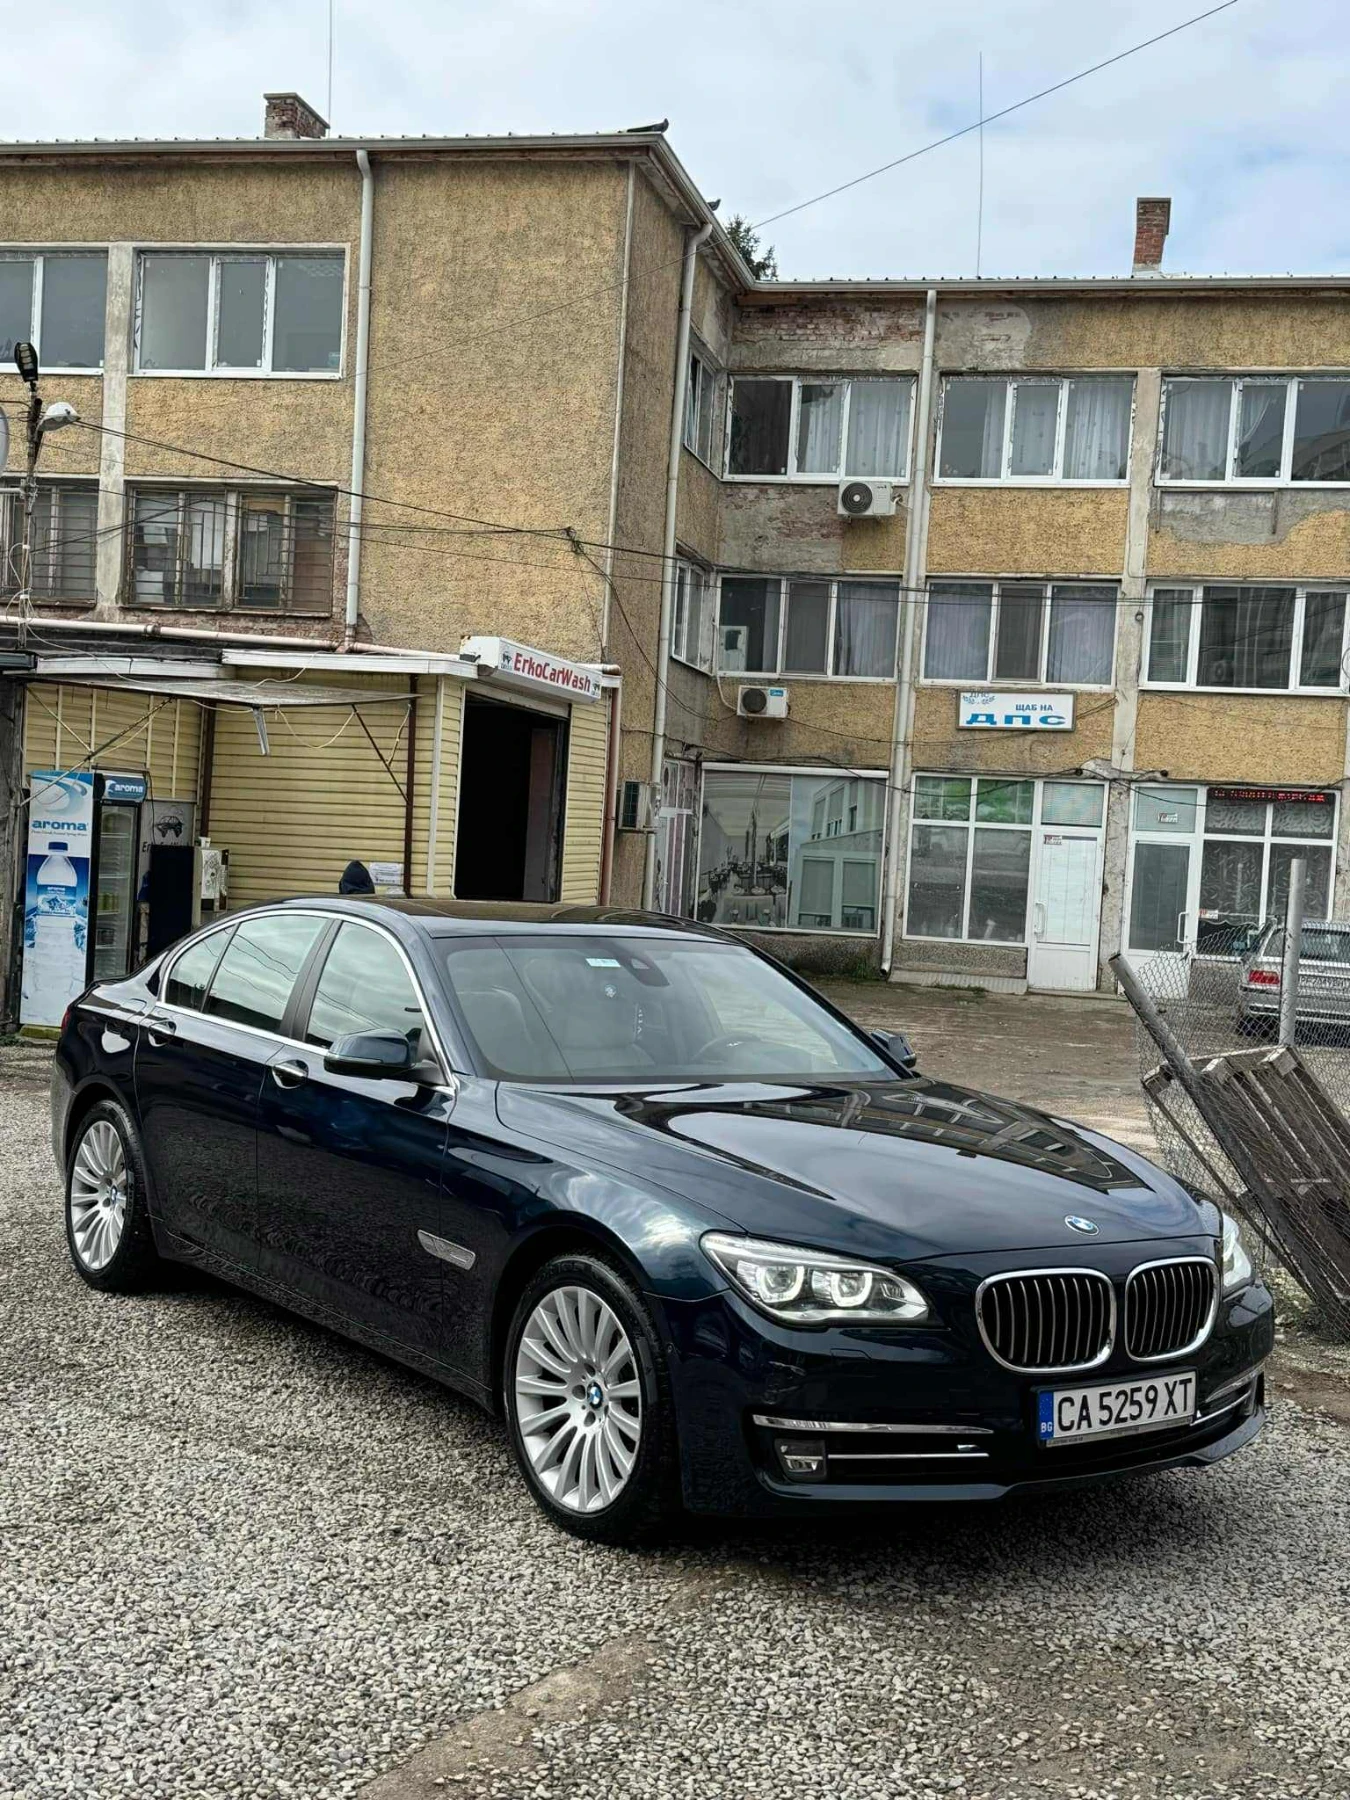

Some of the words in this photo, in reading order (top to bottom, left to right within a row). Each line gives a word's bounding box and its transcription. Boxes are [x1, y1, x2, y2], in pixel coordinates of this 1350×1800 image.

[513, 652, 591, 693] ErkoCarWash
[1015, 703, 1037, 712] ЩАБ
[1040, 703, 1053, 711] НА
[966, 713, 1066, 726] ДПС
[114, 784, 144, 794] aroma
[31, 819, 87, 831] aroma
[1058, 1394, 1092, 1432] CA
[1098, 1384, 1159, 1427] 5259
[1163, 1377, 1193, 1416] XT
[1040, 1421, 1053, 1434] BG
